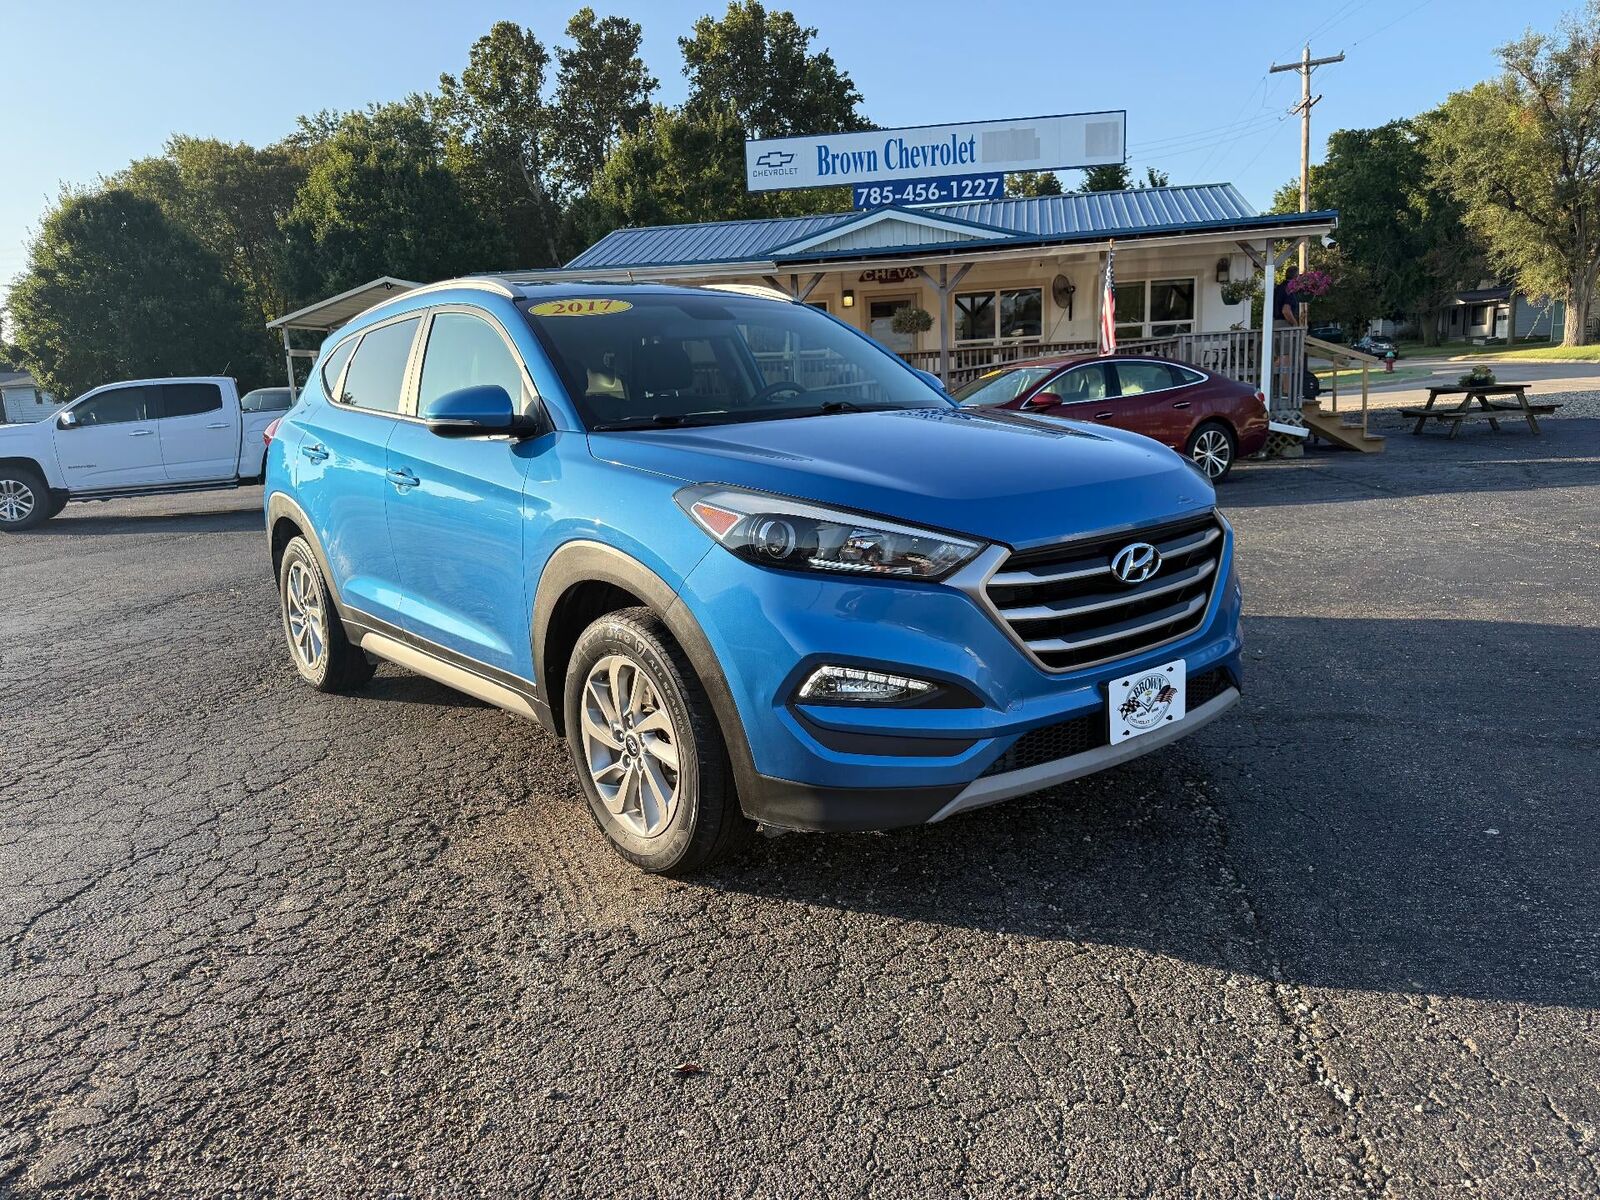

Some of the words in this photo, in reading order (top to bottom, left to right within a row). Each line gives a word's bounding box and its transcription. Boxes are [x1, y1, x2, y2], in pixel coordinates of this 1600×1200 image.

[816, 144, 878, 176] Brown
[884, 133, 977, 171] Chevrolet
[752, 167, 798, 178] CHEVROLET
[857, 178, 1000, 207] 785-456-1227
[552, 300, 613, 314] 2017
[1133, 677, 1165, 699] BROWN
